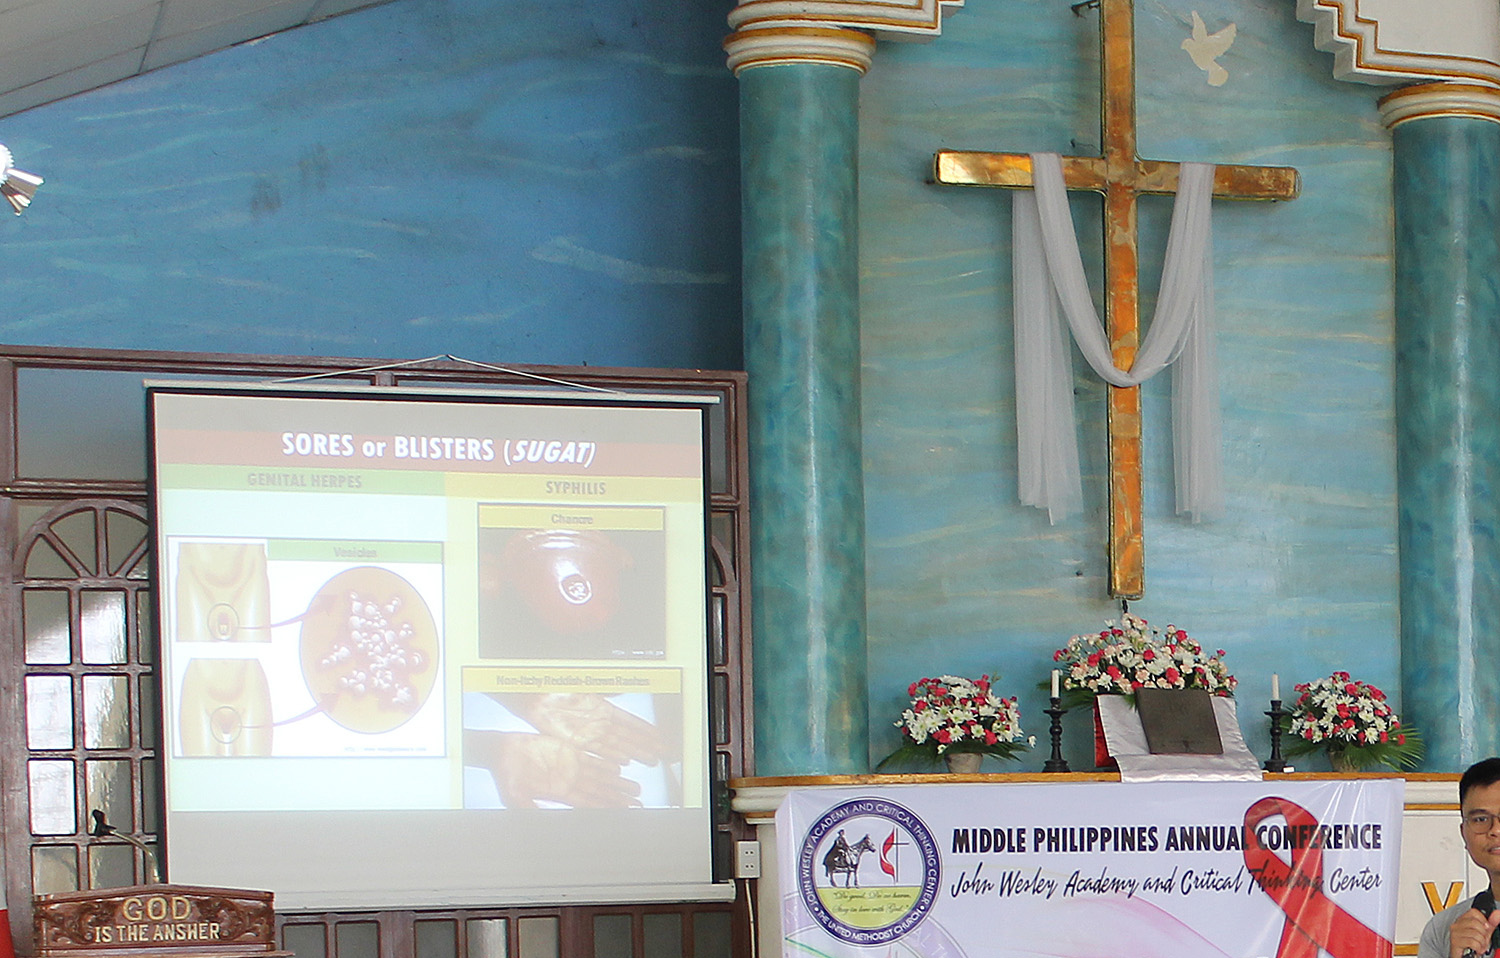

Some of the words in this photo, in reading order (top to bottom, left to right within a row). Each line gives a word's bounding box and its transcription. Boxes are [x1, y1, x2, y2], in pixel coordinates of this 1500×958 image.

[282, 432, 354, 457] SORES
[362, 439, 388, 457] or
[394, 435, 495, 462] BLISTERS
[503, 439, 597, 468] (SUGAT)
[247, 472, 307, 487] GENITAL
[311, 474, 362, 488] HERPES
[546, 480, 606, 495] SYPHILIS
[852, 803, 874, 813] AND
[875, 803, 914, 828] CRITICAL
[810, 807, 850, 842] ACADEMY
[952, 828, 1026, 853] MIDDLE
[1033, 826, 1159, 852] PHILIPPINES
[1165, 826, 1250, 851] ANNUAL
[1256, 824, 1382, 850] CONFERENCE
[913, 824, 937, 867] THINKING
[802, 844, 814, 878] WESLEY
[803, 879, 817, 906] JOHN
[921, 869, 937, 905] CENTER
[951, 861, 995, 898] John
[999, 866, 1058, 899] Wesley
[1063, 866, 1139, 899] Academy
[1143, 865, 1178, 894] and
[1180, 865, 1245, 895] Critical
[1248, 859, 1324, 899] Thinking
[1329, 866, 1383, 894] Center
[122, 896, 193, 922] GOD
[95, 925, 112, 943] IS
[117, 924, 149, 943] THE
[152, 922, 221, 942] ANSWER
[816, 910, 829, 925] THE
[827, 919, 852, 938] UNITED
[851, 929, 894, 941] METHODIST
[894, 907, 923, 934] CHURCH
